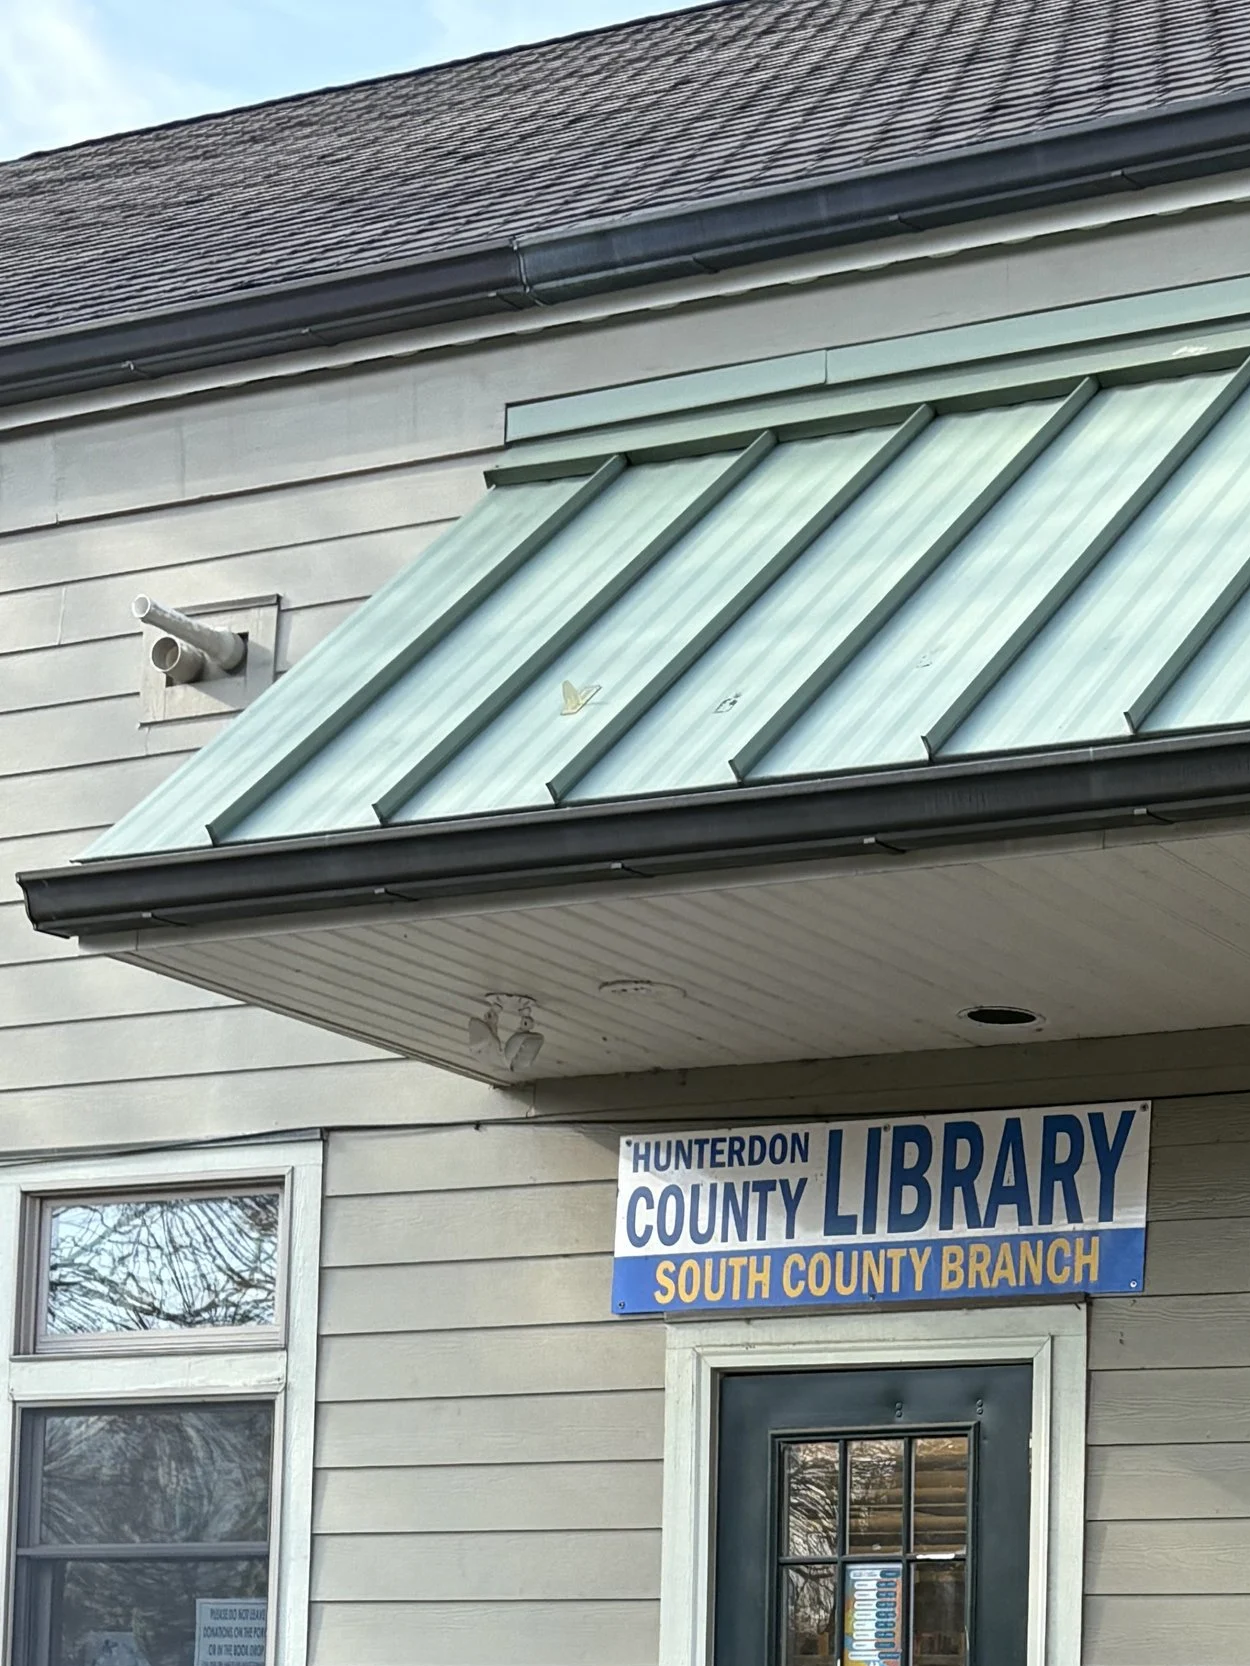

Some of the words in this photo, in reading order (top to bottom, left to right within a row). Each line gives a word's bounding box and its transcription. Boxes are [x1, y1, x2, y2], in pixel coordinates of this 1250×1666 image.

[632, 1132, 809, 1173] HUNTERDON
[823, 1110, 1136, 1237] LIBRARY
[626, 1178, 808, 1248] COUNTY
[654, 1256, 770, 1304] SOUTH
[783, 1246, 932, 1296] COUNTY
[940, 1236, 1099, 1290] BRANCH
